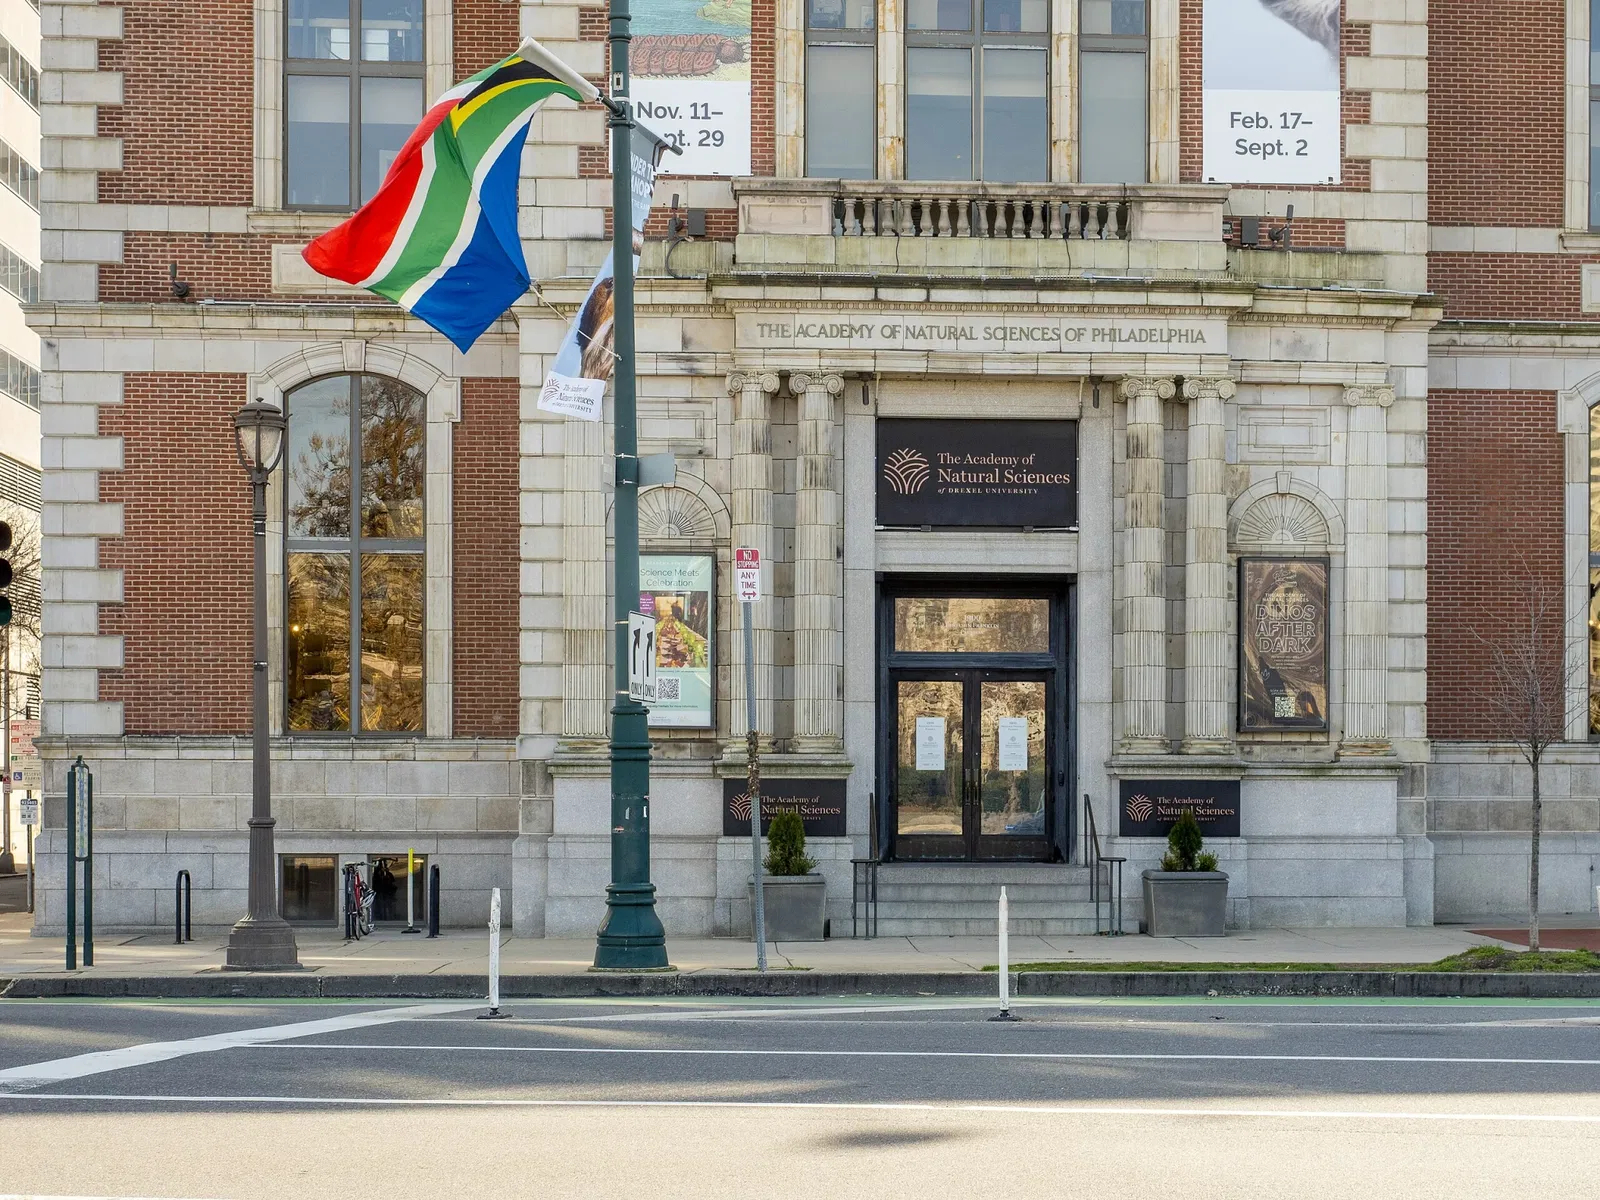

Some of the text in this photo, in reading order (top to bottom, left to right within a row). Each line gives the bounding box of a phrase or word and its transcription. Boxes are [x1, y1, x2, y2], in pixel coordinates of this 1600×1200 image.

[637, 101, 682, 119] Nov.
[1230, 111, 1273, 129] Feb.
[698, 129, 725, 148] 29
[1235, 138, 1308, 161] Sept. 2
[757, 323, 1207, 344] THE ACADEMY OF NATURAL SCIENCES OF PHILADELPHIA
[937, 453, 1036, 468] The Academy of
[937, 468, 1071, 484] Natural Sciences
[743, 551, 753, 561] NO
[737, 561, 759, 569] STOPPING
[640, 569, 700, 577] Science Meets
[646, 579, 694, 587] Celebration
[1256, 604, 1315, 621] DINOS
[1255, 621, 1316, 637] AFTER
[1260, 637, 1311, 653] DARK
[631, 682, 656, 697] ONLY ONLY
[777, 796, 810, 804] Academy
[1172, 797, 1204, 805] Academy
[800, 805, 841, 814] Sciences
[1195, 806, 1235, 815] Sciences
